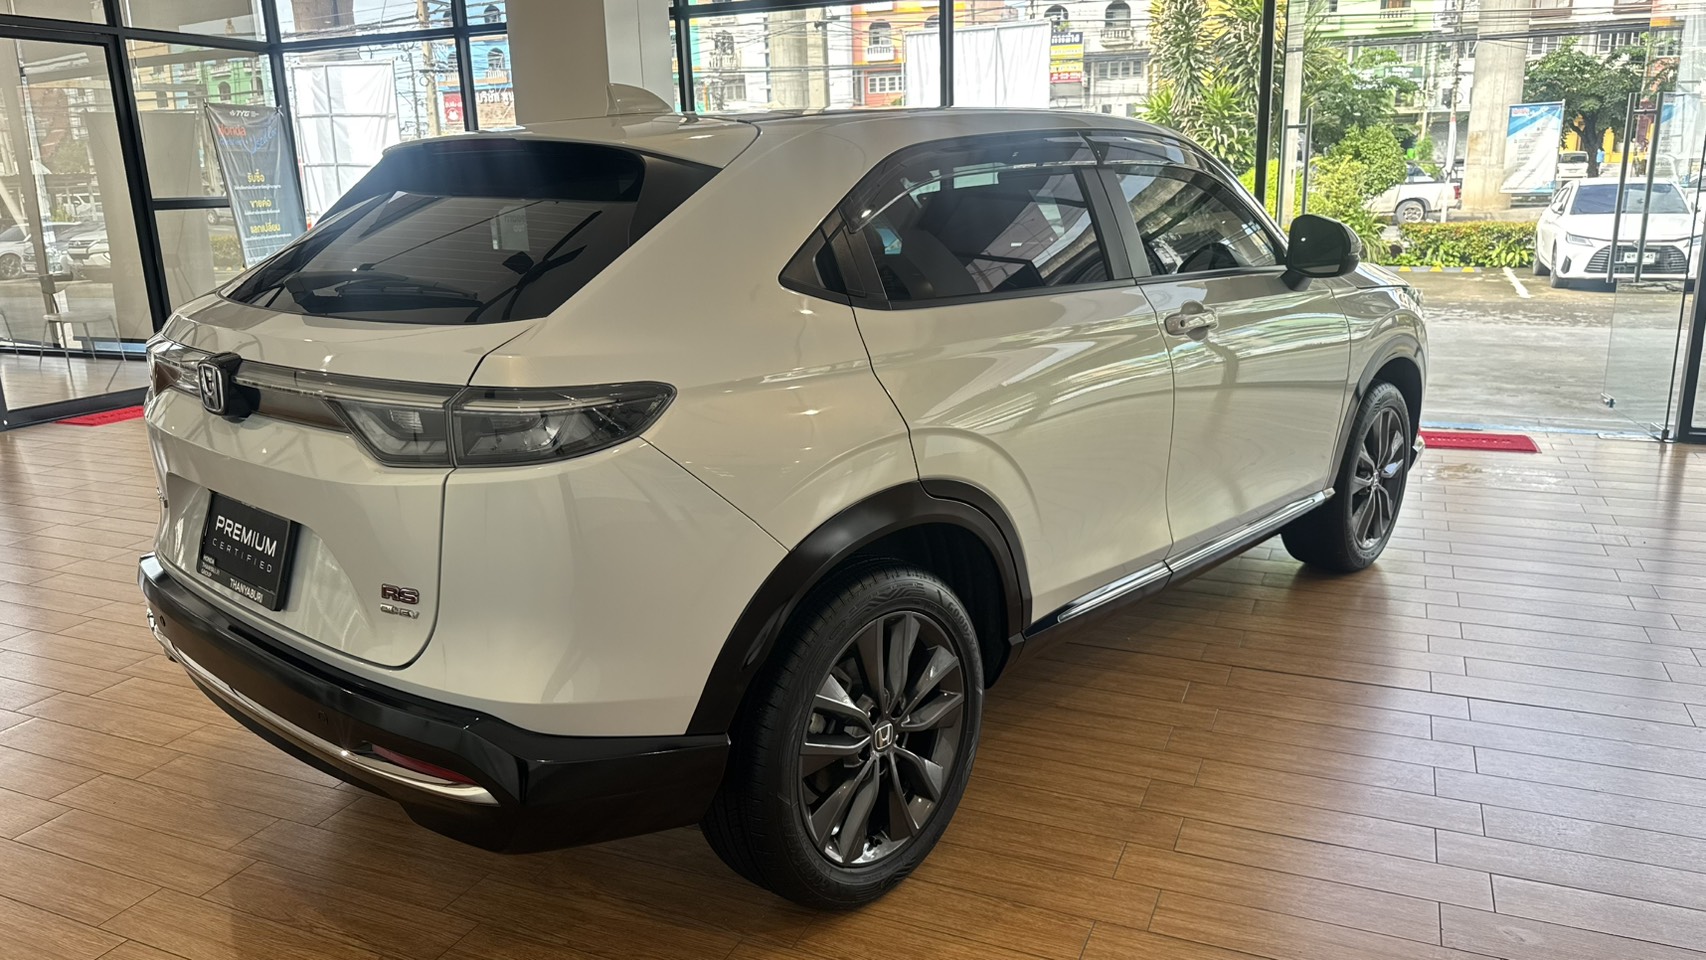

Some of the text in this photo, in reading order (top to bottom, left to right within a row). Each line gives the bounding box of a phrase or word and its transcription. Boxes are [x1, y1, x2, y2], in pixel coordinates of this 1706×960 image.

[215, 515, 277, 558] PREMIUM
[212, 537, 272, 573] CERTIFIED
[230, 578, 264, 603] THANYABURI
[381, 583, 419, 604] RS
